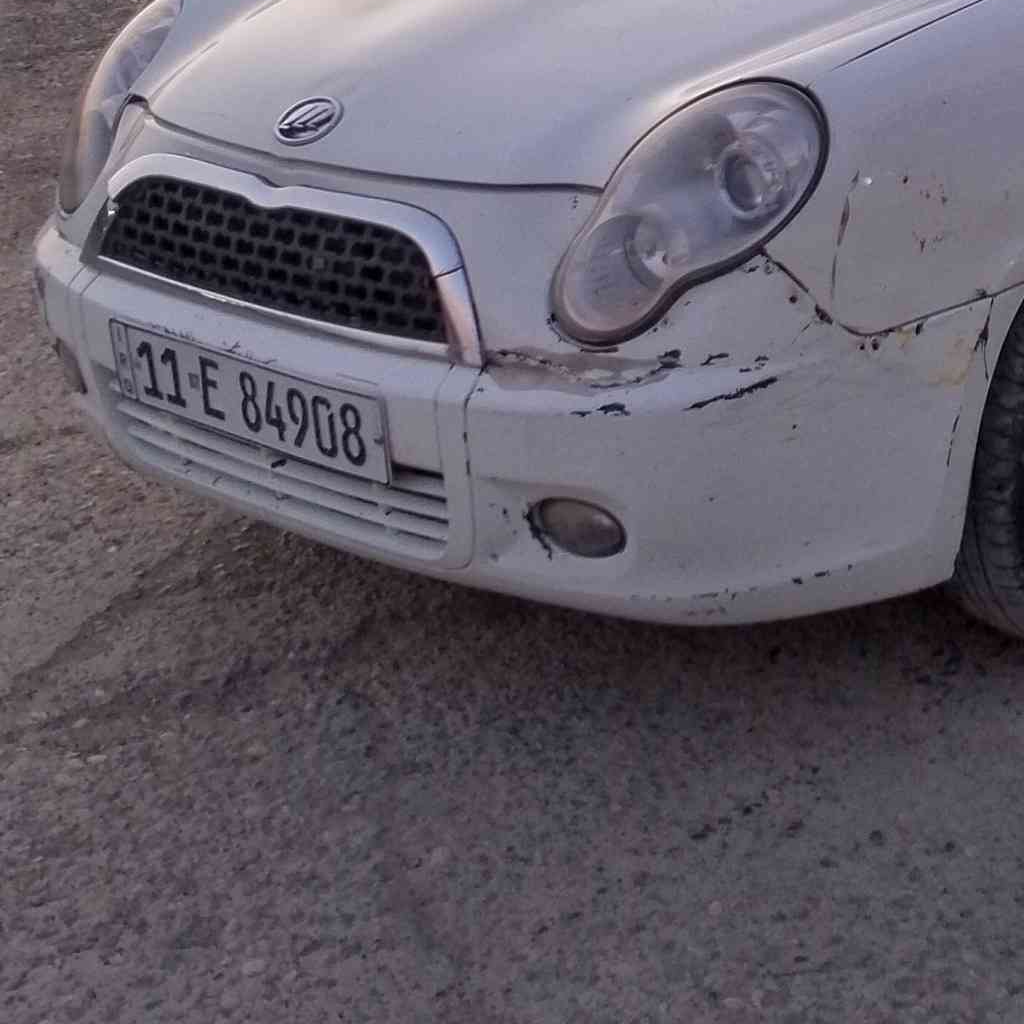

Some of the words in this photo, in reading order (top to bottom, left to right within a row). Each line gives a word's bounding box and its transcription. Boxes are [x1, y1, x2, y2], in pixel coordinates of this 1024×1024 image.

[136, 340, 187, 409] 11
[199, 355, 226, 421] E
[238, 370, 367, 467] 84908
